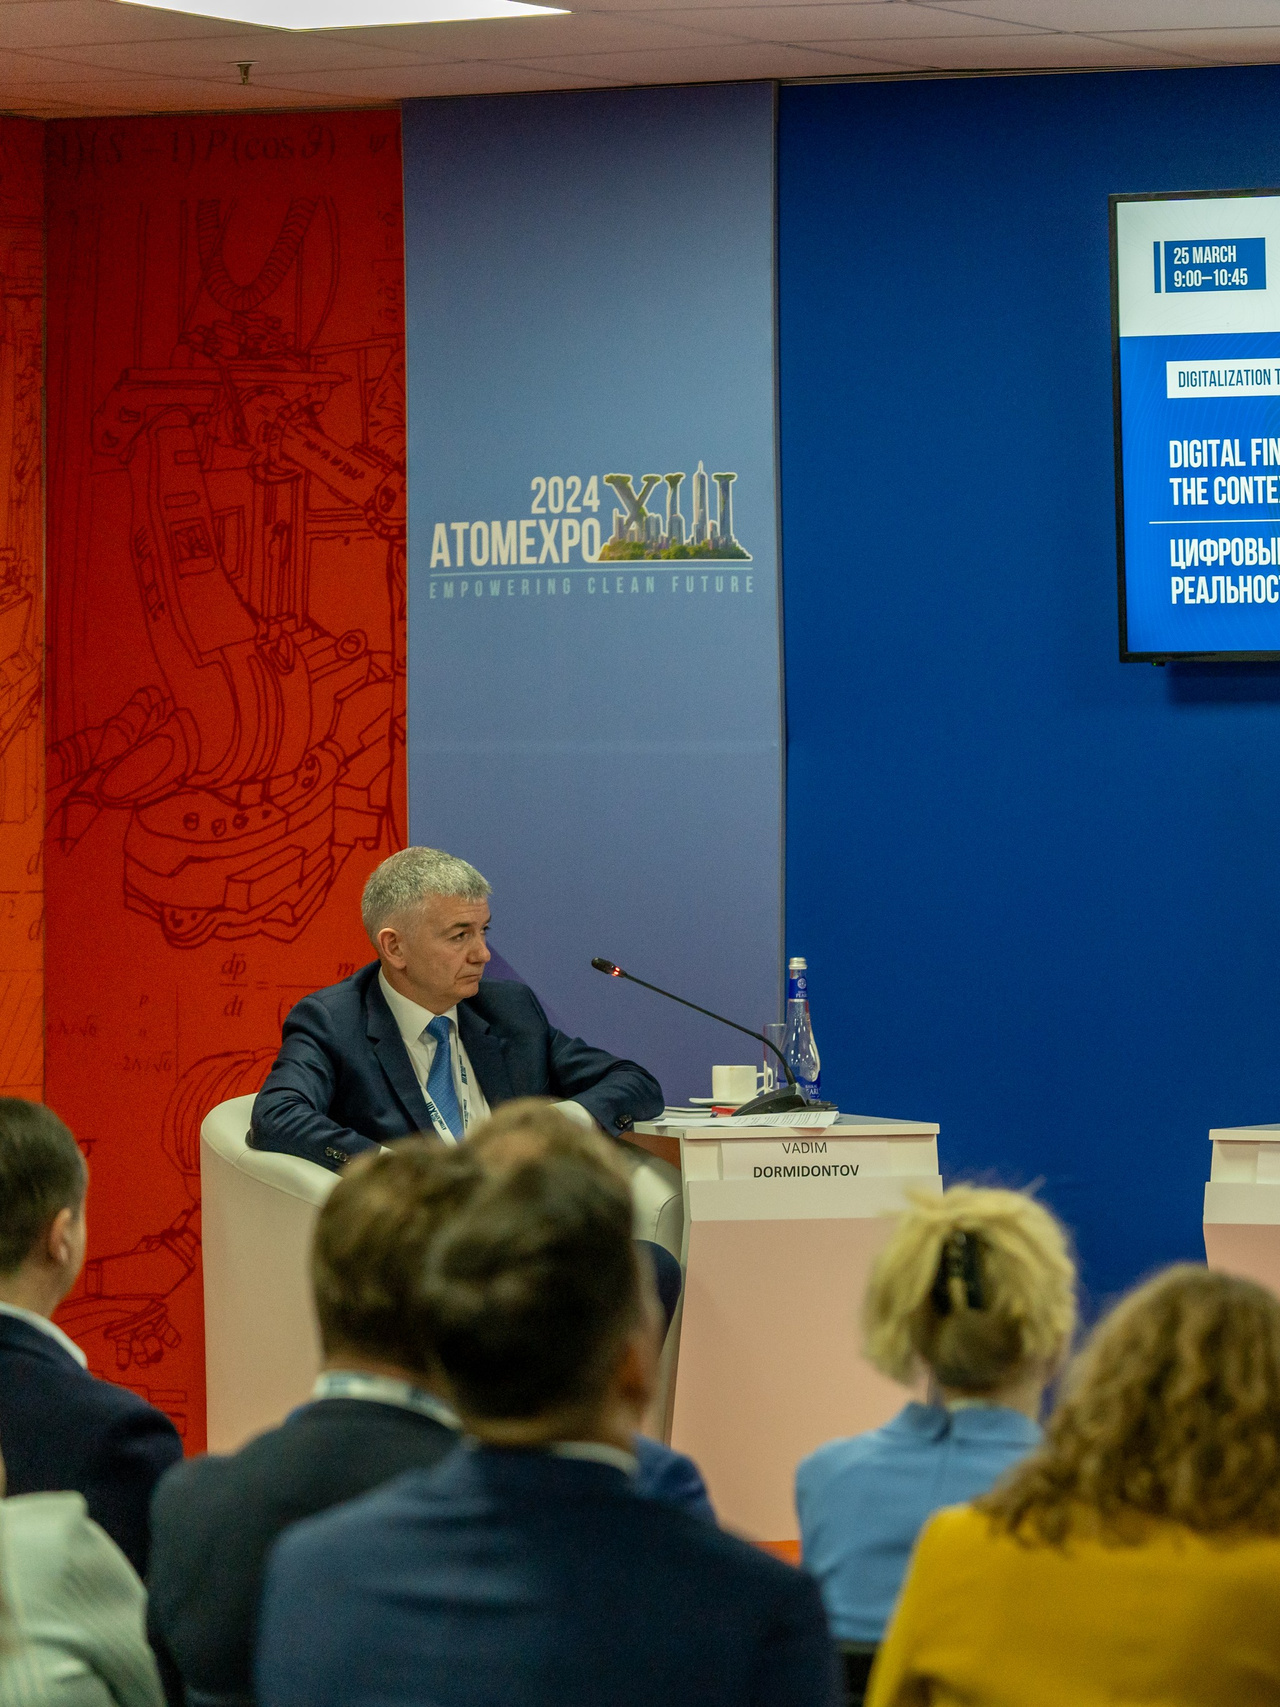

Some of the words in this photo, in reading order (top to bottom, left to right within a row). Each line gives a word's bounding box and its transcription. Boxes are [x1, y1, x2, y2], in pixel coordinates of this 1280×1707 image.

[1173, 247, 1190, 265] 25
[1192, 245, 1237, 264] MARCH
[1178, 368, 1271, 388] DIGITALIZATION
[1169, 438, 1246, 468] DIGITAL
[530, 475, 600, 515] 2024
[1169, 476, 1209, 506] THE
[429, 517, 601, 568] ATOMEXPO
[429, 577, 571, 599] EMPOWERING
[587, 575, 655, 594] CLEAN
[671, 574, 754, 594] FUTURE
[782, 1141, 828, 1155] VADIM
[753, 1164, 860, 1178] DORMIDONTOV
